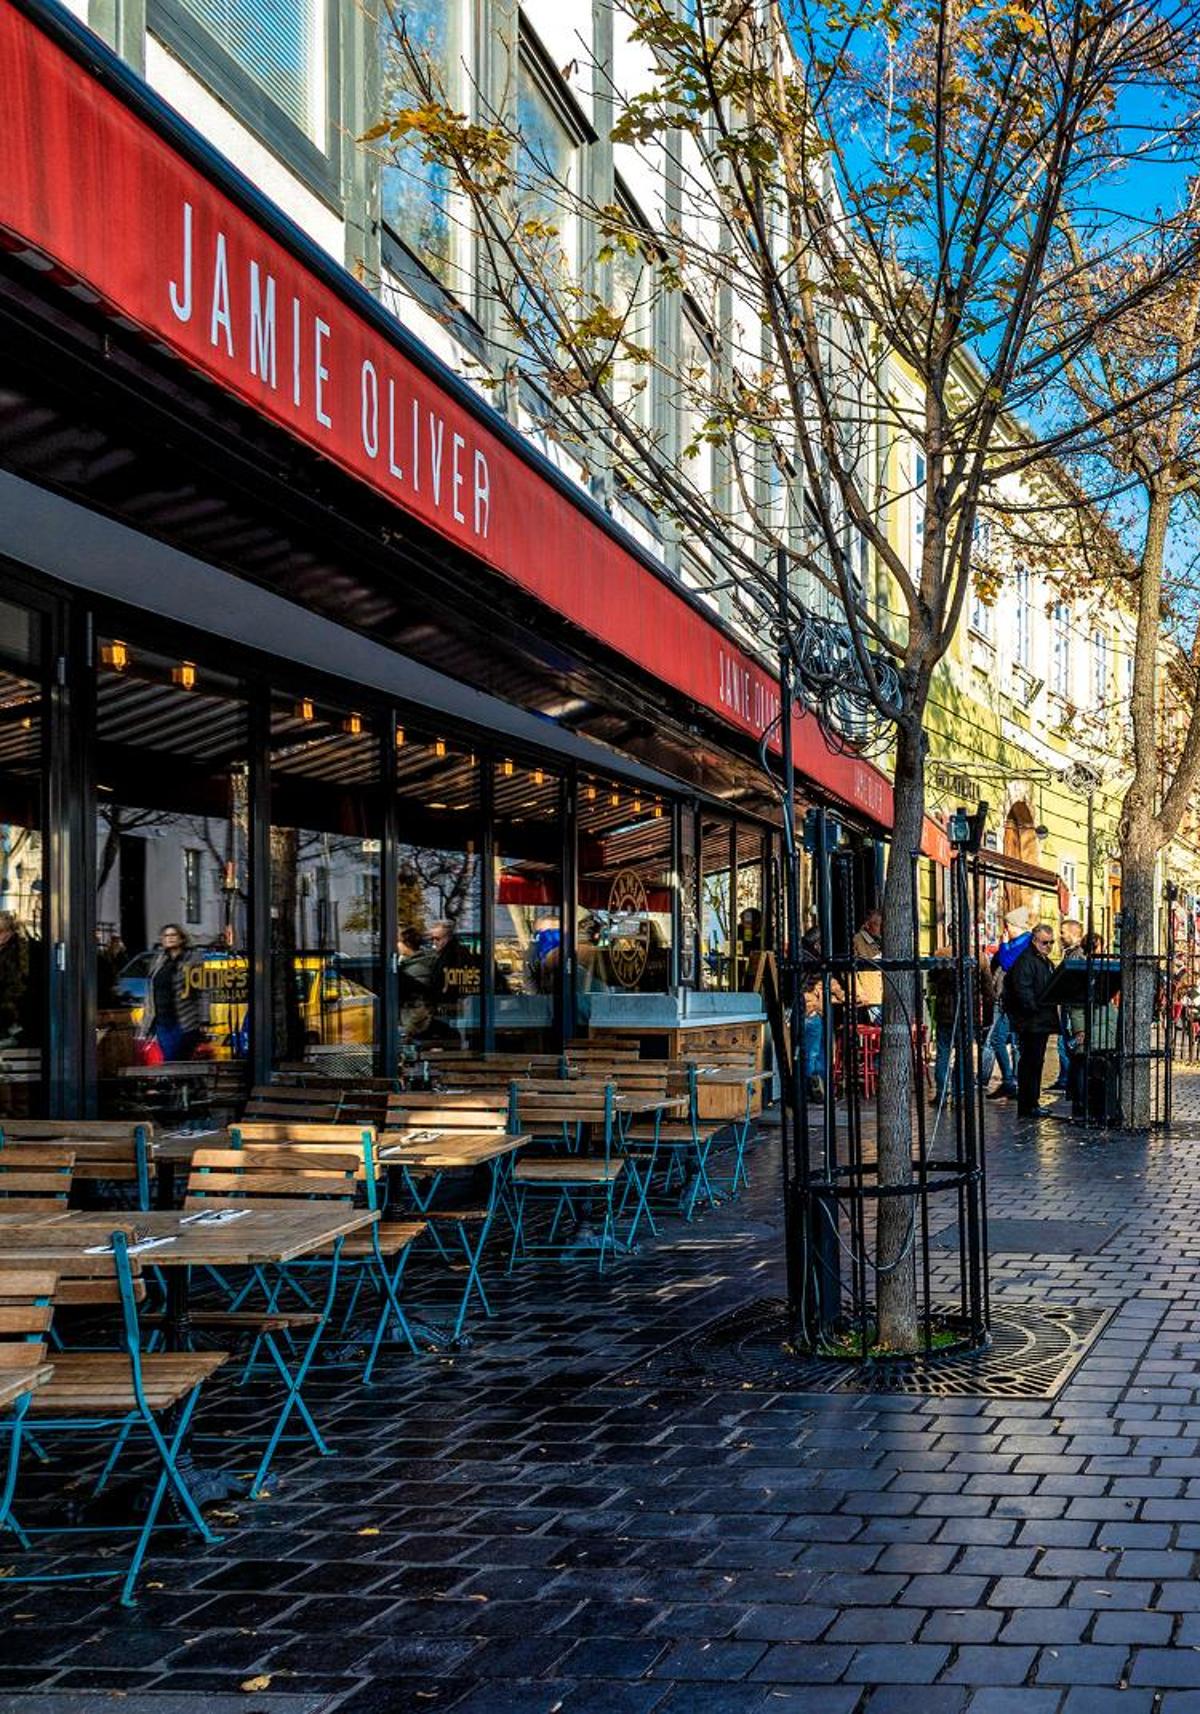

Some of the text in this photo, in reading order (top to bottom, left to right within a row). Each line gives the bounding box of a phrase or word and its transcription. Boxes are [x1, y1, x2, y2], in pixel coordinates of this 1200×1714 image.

[168, 201, 490, 540] JAMIE OLIVER
[719, 649, 751, 722] JAMIE
